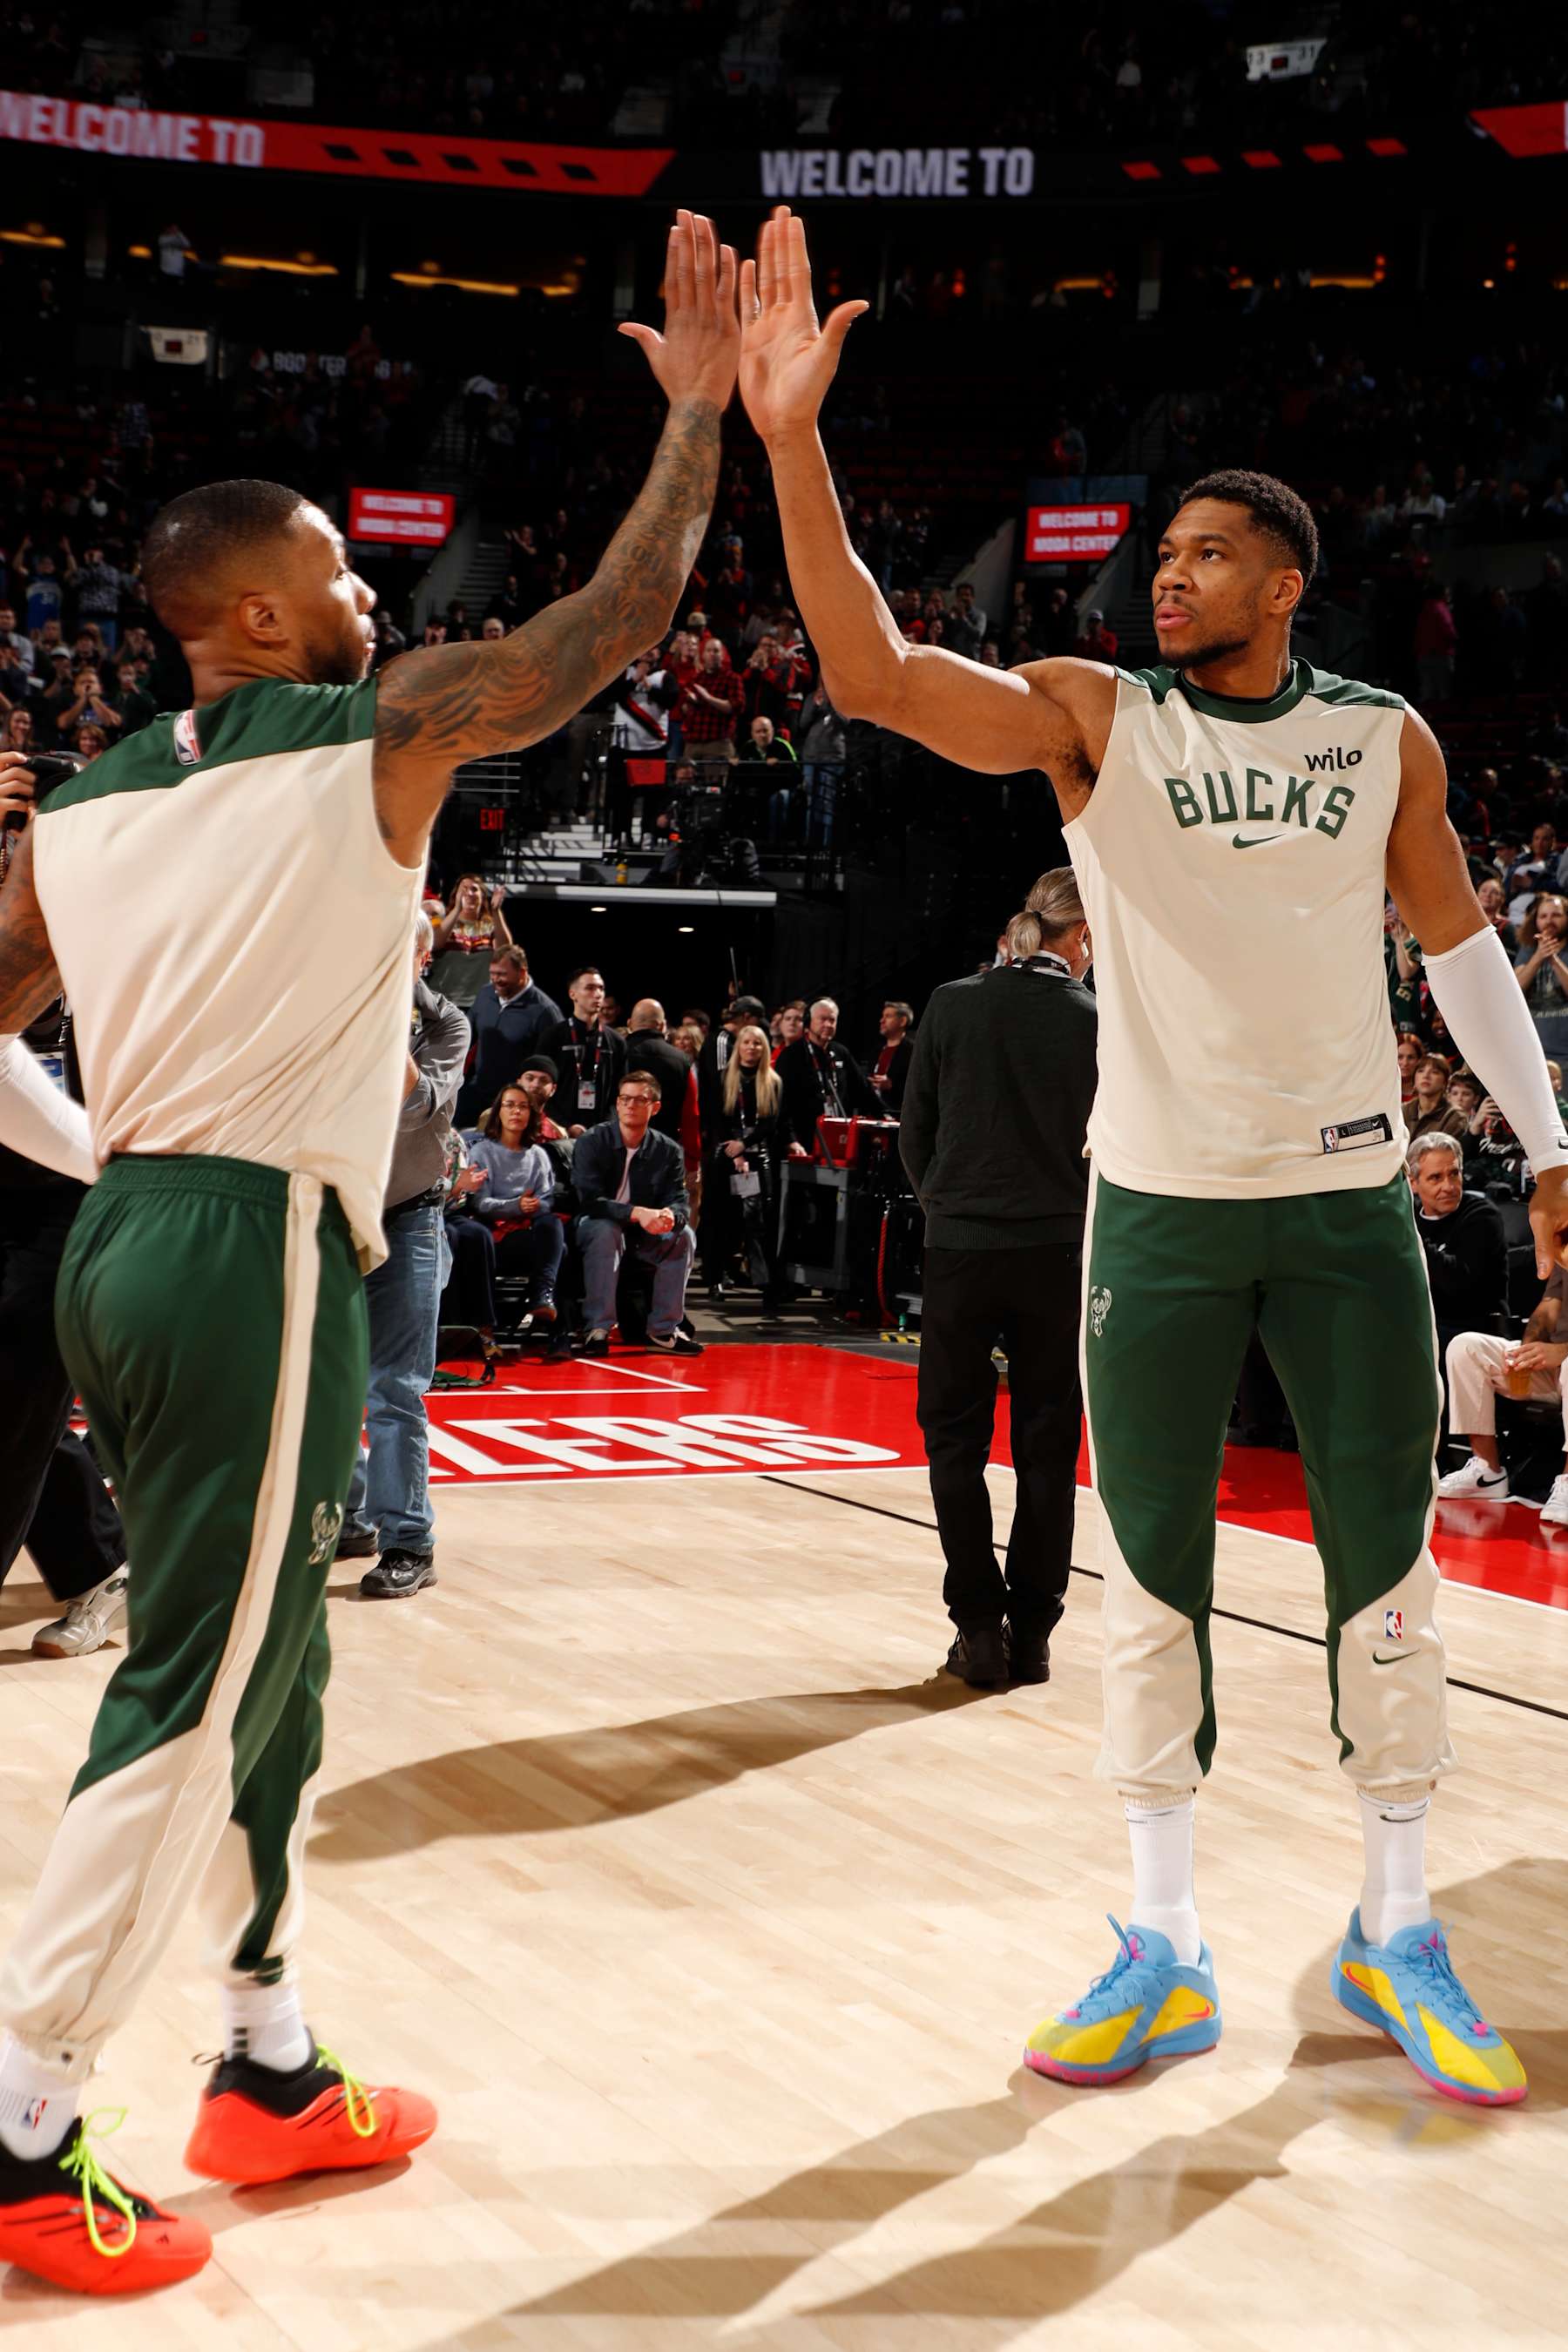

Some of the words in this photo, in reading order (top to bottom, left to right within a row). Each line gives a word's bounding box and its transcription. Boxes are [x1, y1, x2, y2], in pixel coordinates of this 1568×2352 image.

[206, 118, 265, 168] TO
[760, 147, 970, 198] WELCOME
[977, 146, 1035, 197] TO
[1038, 510, 1098, 529] WELCOME
[1100, 510, 1119, 528] TO
[1303, 747, 1362, 772] wilo
[480, 808, 504, 830] EXIT
[1163, 767, 1355, 840] BUCKS
